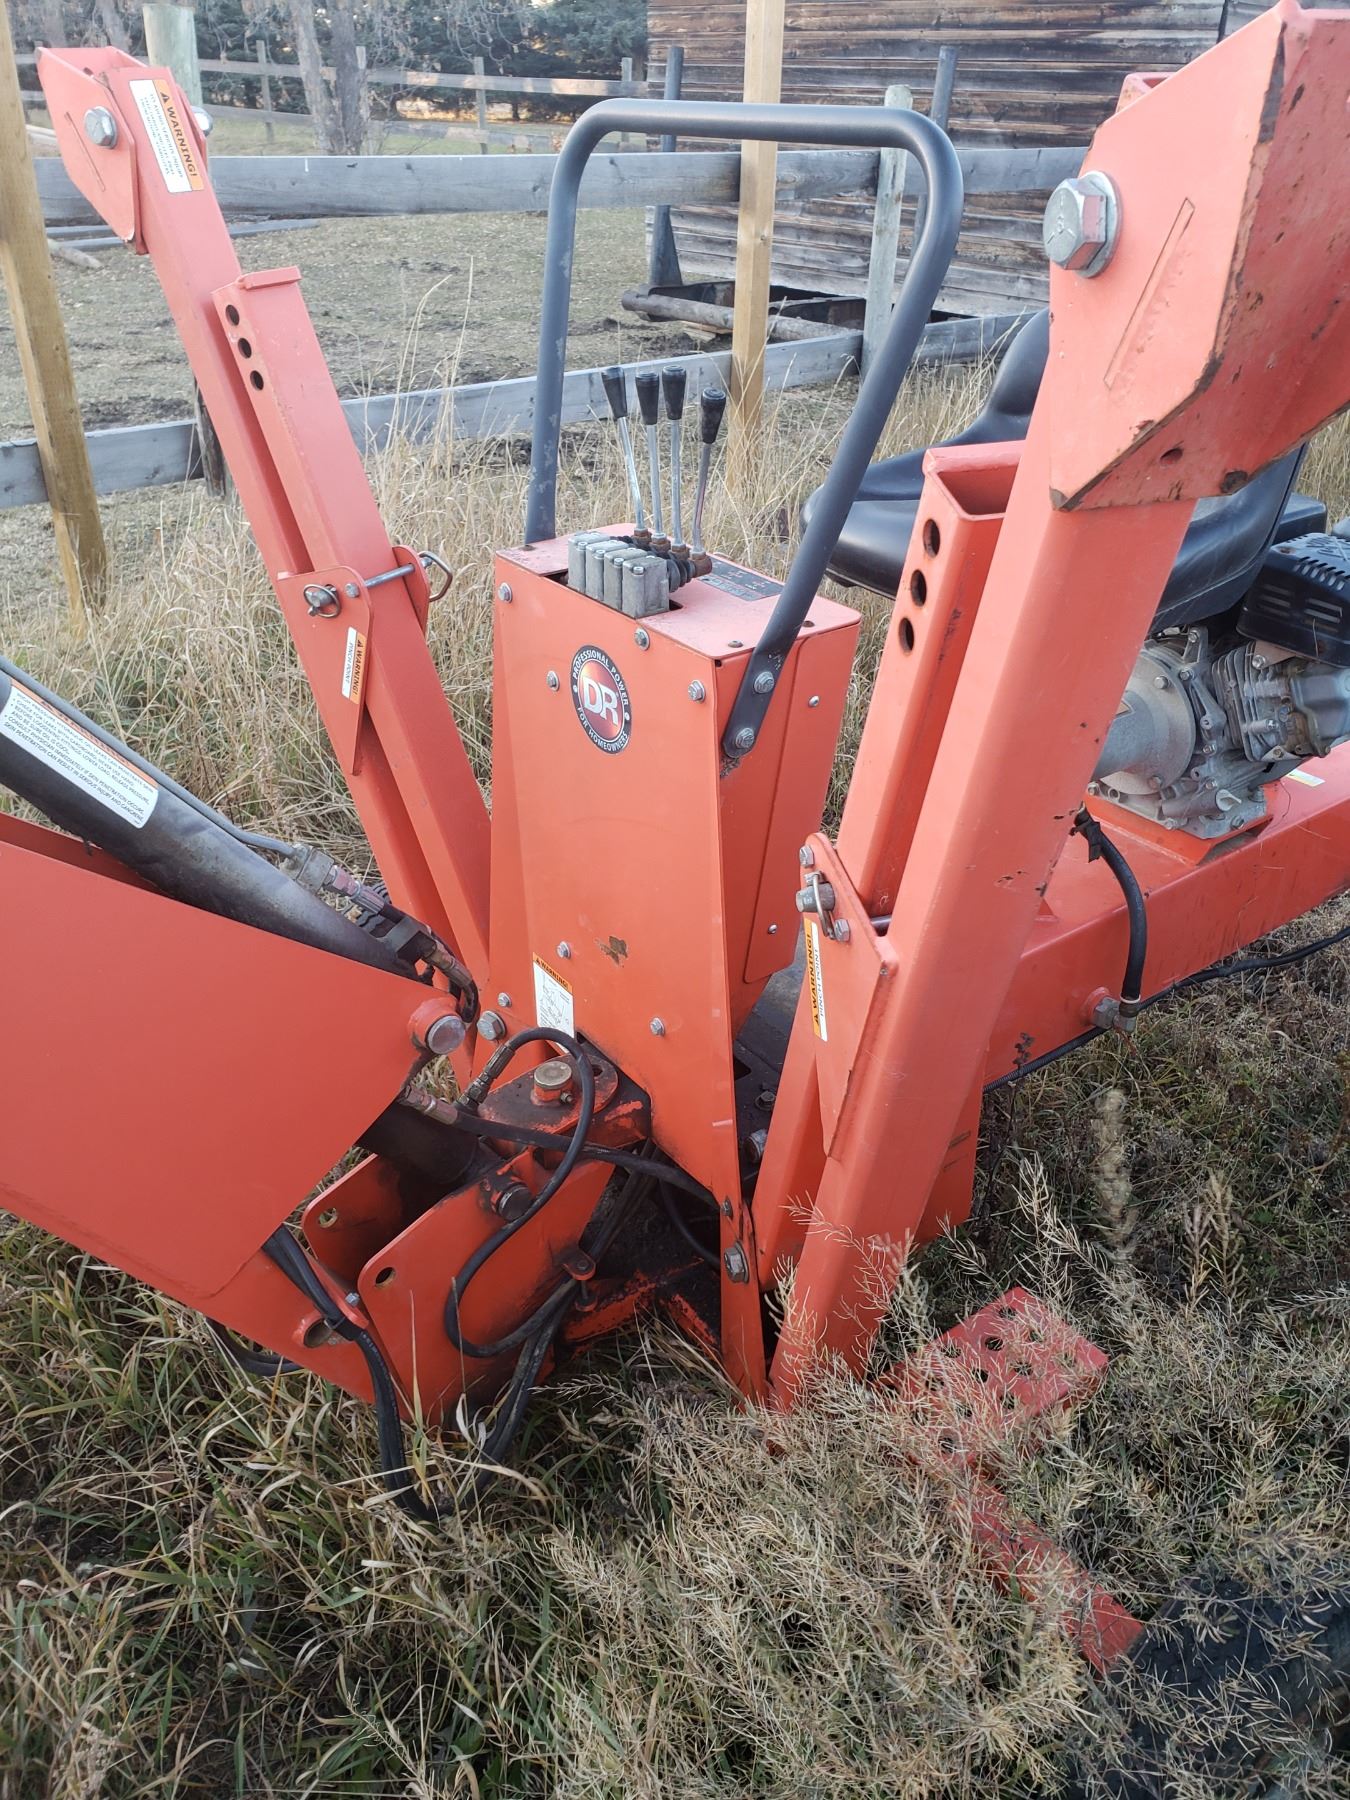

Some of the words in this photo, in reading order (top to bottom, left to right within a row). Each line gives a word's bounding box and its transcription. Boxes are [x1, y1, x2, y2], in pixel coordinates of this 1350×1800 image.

[167, 106, 198, 176] WARNING!
[352, 650, 363, 695] WARNING!
[573, 649, 609, 680] PROFESSIONAL
[611, 667, 629, 706] POWER
[582, 675, 619, 726] DR
[577, 707, 588, 728] FOR
[588, 730, 628, 752] HOMEOWNERS
[806, 934, 817, 1008] WARNING!
